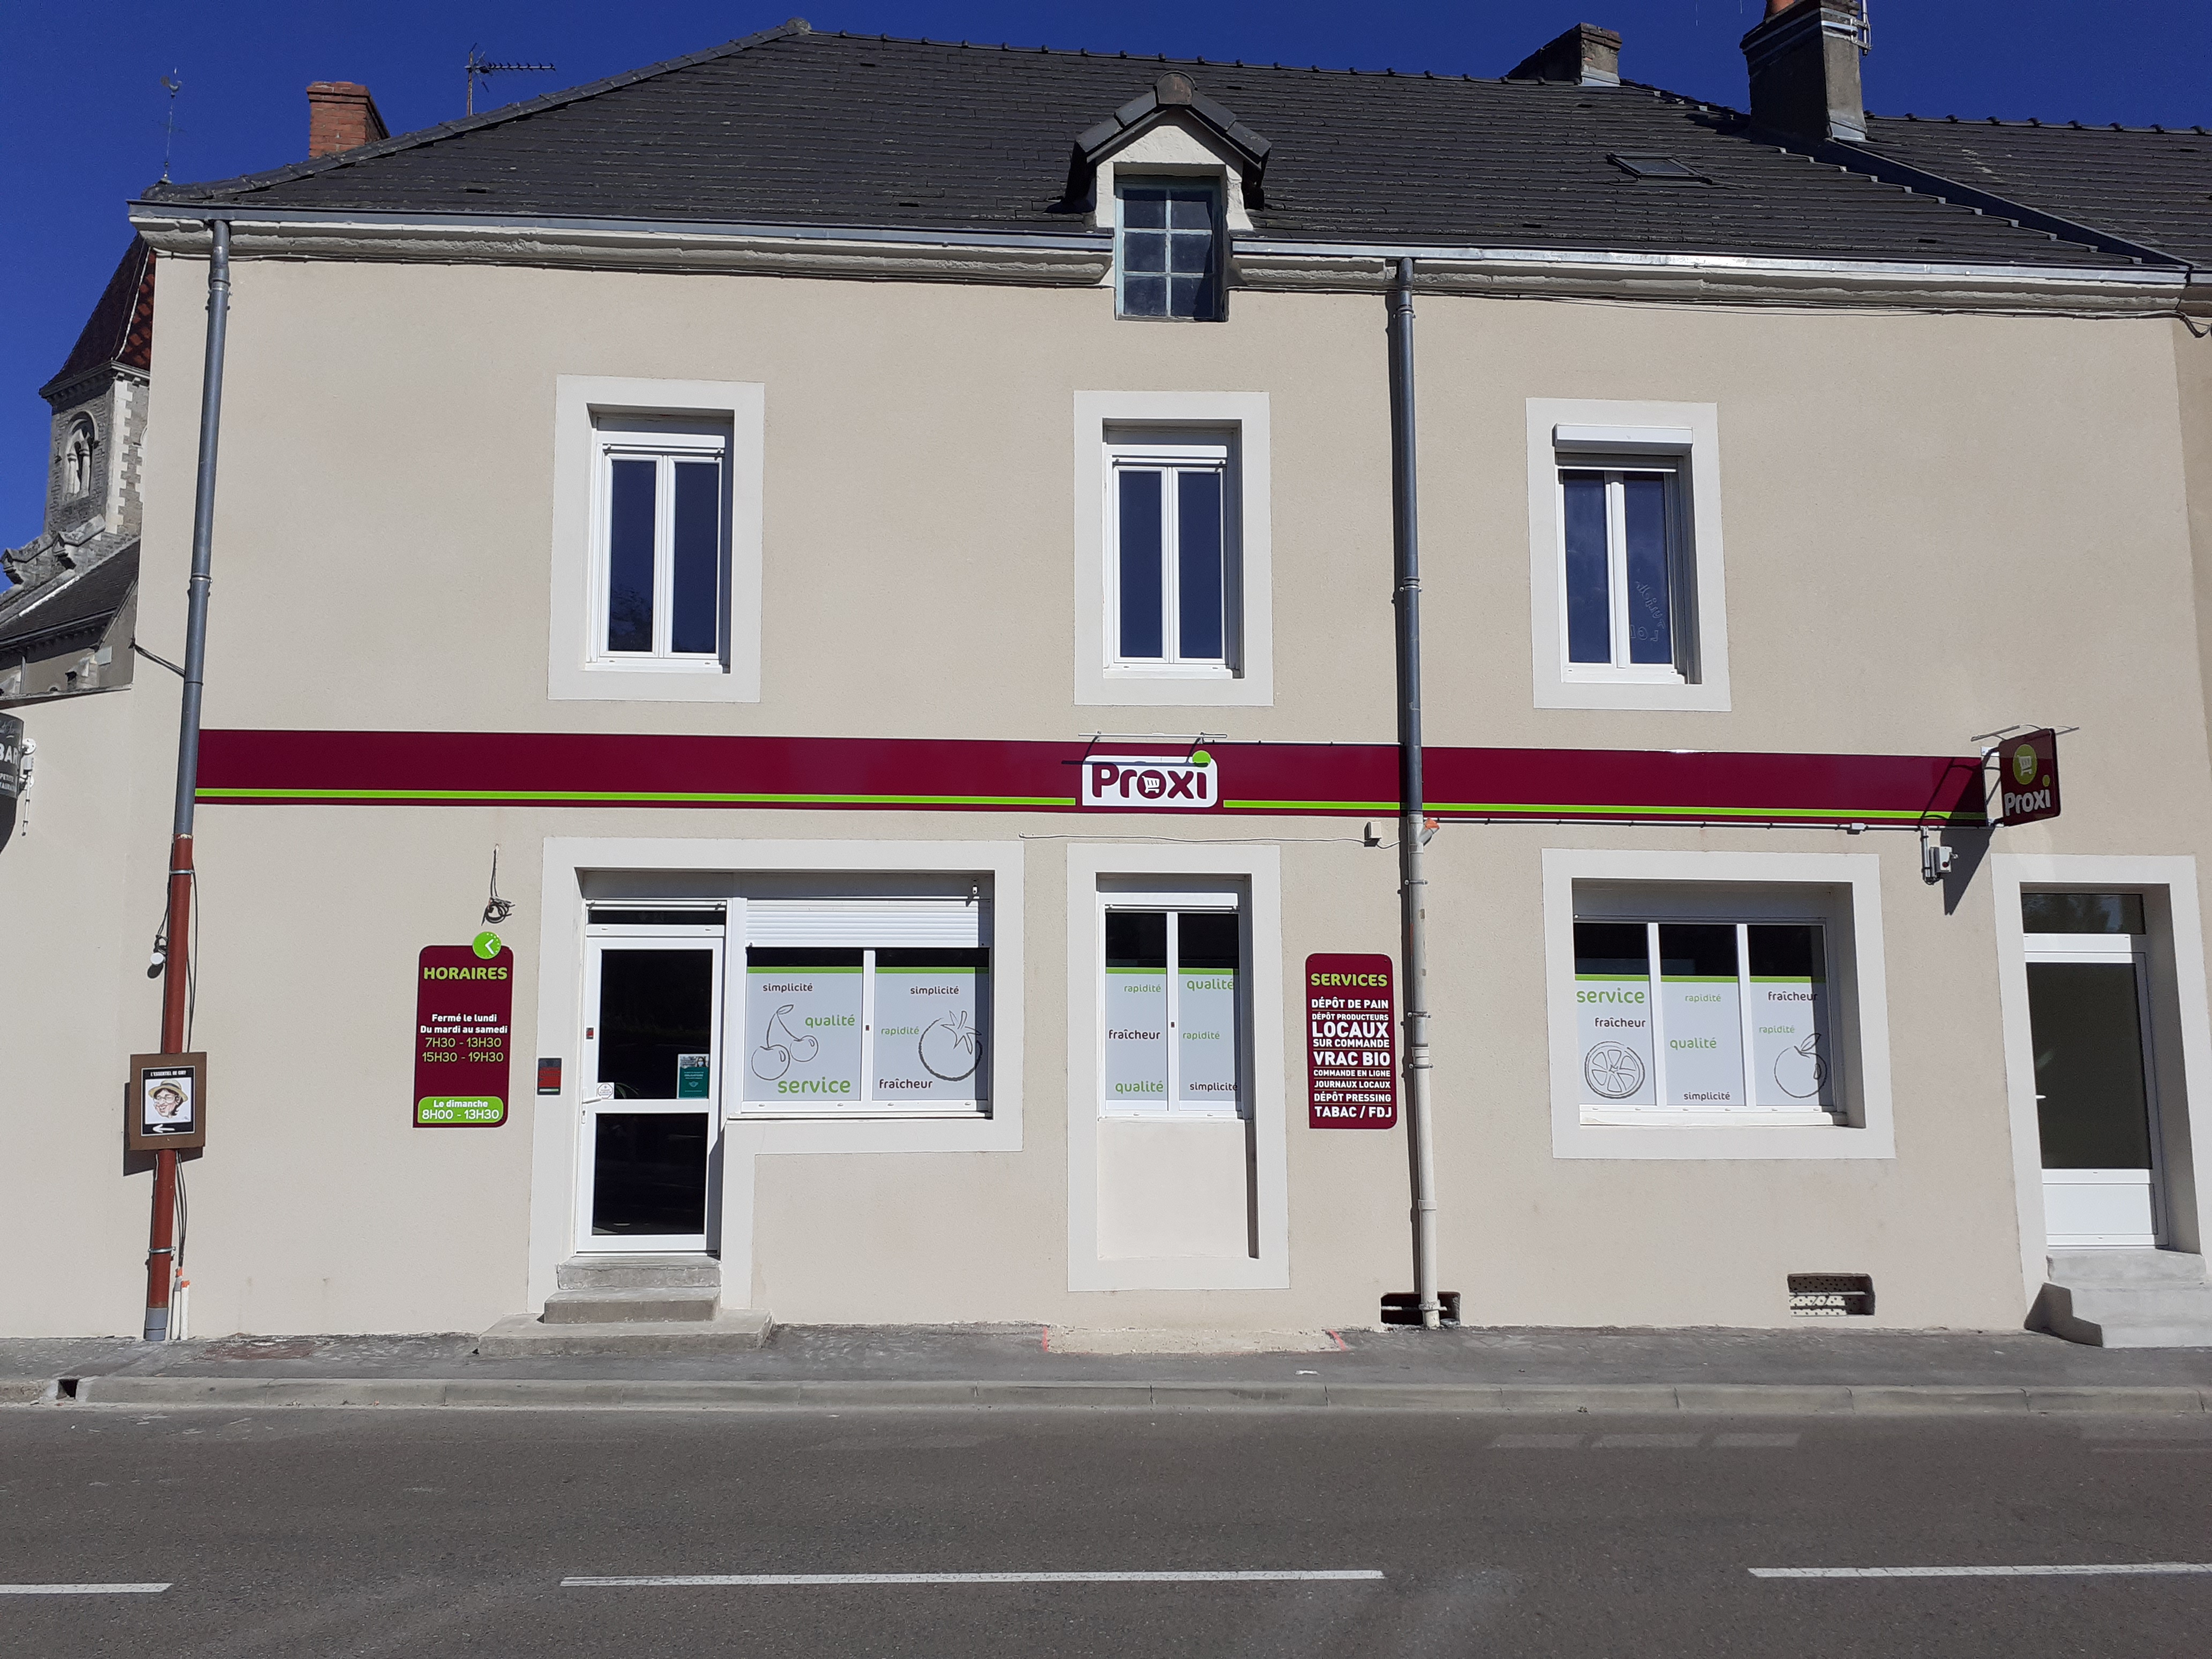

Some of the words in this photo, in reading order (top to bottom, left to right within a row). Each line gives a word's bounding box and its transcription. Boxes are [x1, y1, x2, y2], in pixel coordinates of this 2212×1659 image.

[423, 967, 507, 980] HORAIRES
[1186, 978, 1234, 991] qualité
[1311, 973, 1387, 986] SERVICES
[763, 983, 813, 993] simplicité
[910, 986, 959, 996] simplicité
[1124, 984, 1161, 993] rapidité
[1576, 987, 1645, 1004] service
[1685, 994, 1721, 1003] rapidité
[1768, 991, 1818, 1002] fraîcheur
[1312, 997, 1344, 1008] DÉPÔT
[1348, 1000, 1361, 1008] DE
[1364, 1000, 1388, 1008] PAIN
[432, 1013, 461, 1022] Fermé
[805, 1014, 855, 1028] qualité
[1312, 1012, 1335, 1020] DÉPÔT
[1595, 1018, 1646, 1028] fraîcheur
[421, 1026, 432, 1034] Du
[435, 1026, 461, 1034] mardi
[475, 1026, 507, 1034] samedi
[881, 1027, 920, 1036] rapidité
[1109, 1029, 1161, 1040] fraîcheur
[1312, 1022, 1389, 1038] LOCAUX
[1759, 1026, 1795, 1034] rapidité
[1183, 1032, 1220, 1041] rapidité
[425, 1037, 455, 1048] 7H30
[466, 1038, 502, 1048] 13H30
[1313, 1039, 1332, 1047] SUR
[1334, 1039, 1389, 1048] COMMANDE
[1669, 1037, 1717, 1050] qualité
[422, 1052, 457, 1062] 15H30
[468, 1052, 504, 1062] 19H30
[1313, 1051, 1358, 1065] VRAC
[1363, 1052, 1390, 1065] BIO
[778, 1077, 851, 1093] service
[879, 1079, 933, 1089] fraîcheur
[1115, 1081, 1163, 1094] qualité
[1190, 1082, 1238, 1092] simplicité
[1314, 1091, 1343, 1102] DÉPÔT
[1346, 1094, 1391, 1102] PRESSING
[1684, 1092, 1730, 1102] simplicité
[422, 1109, 453, 1119] 8H00
[464, 1109, 499, 1119] 13H30
[1314, 1107, 1357, 1117] TABAC
[1359, 1106, 1365, 1118] /
[1369, 1107, 1392, 1117] FDJ
